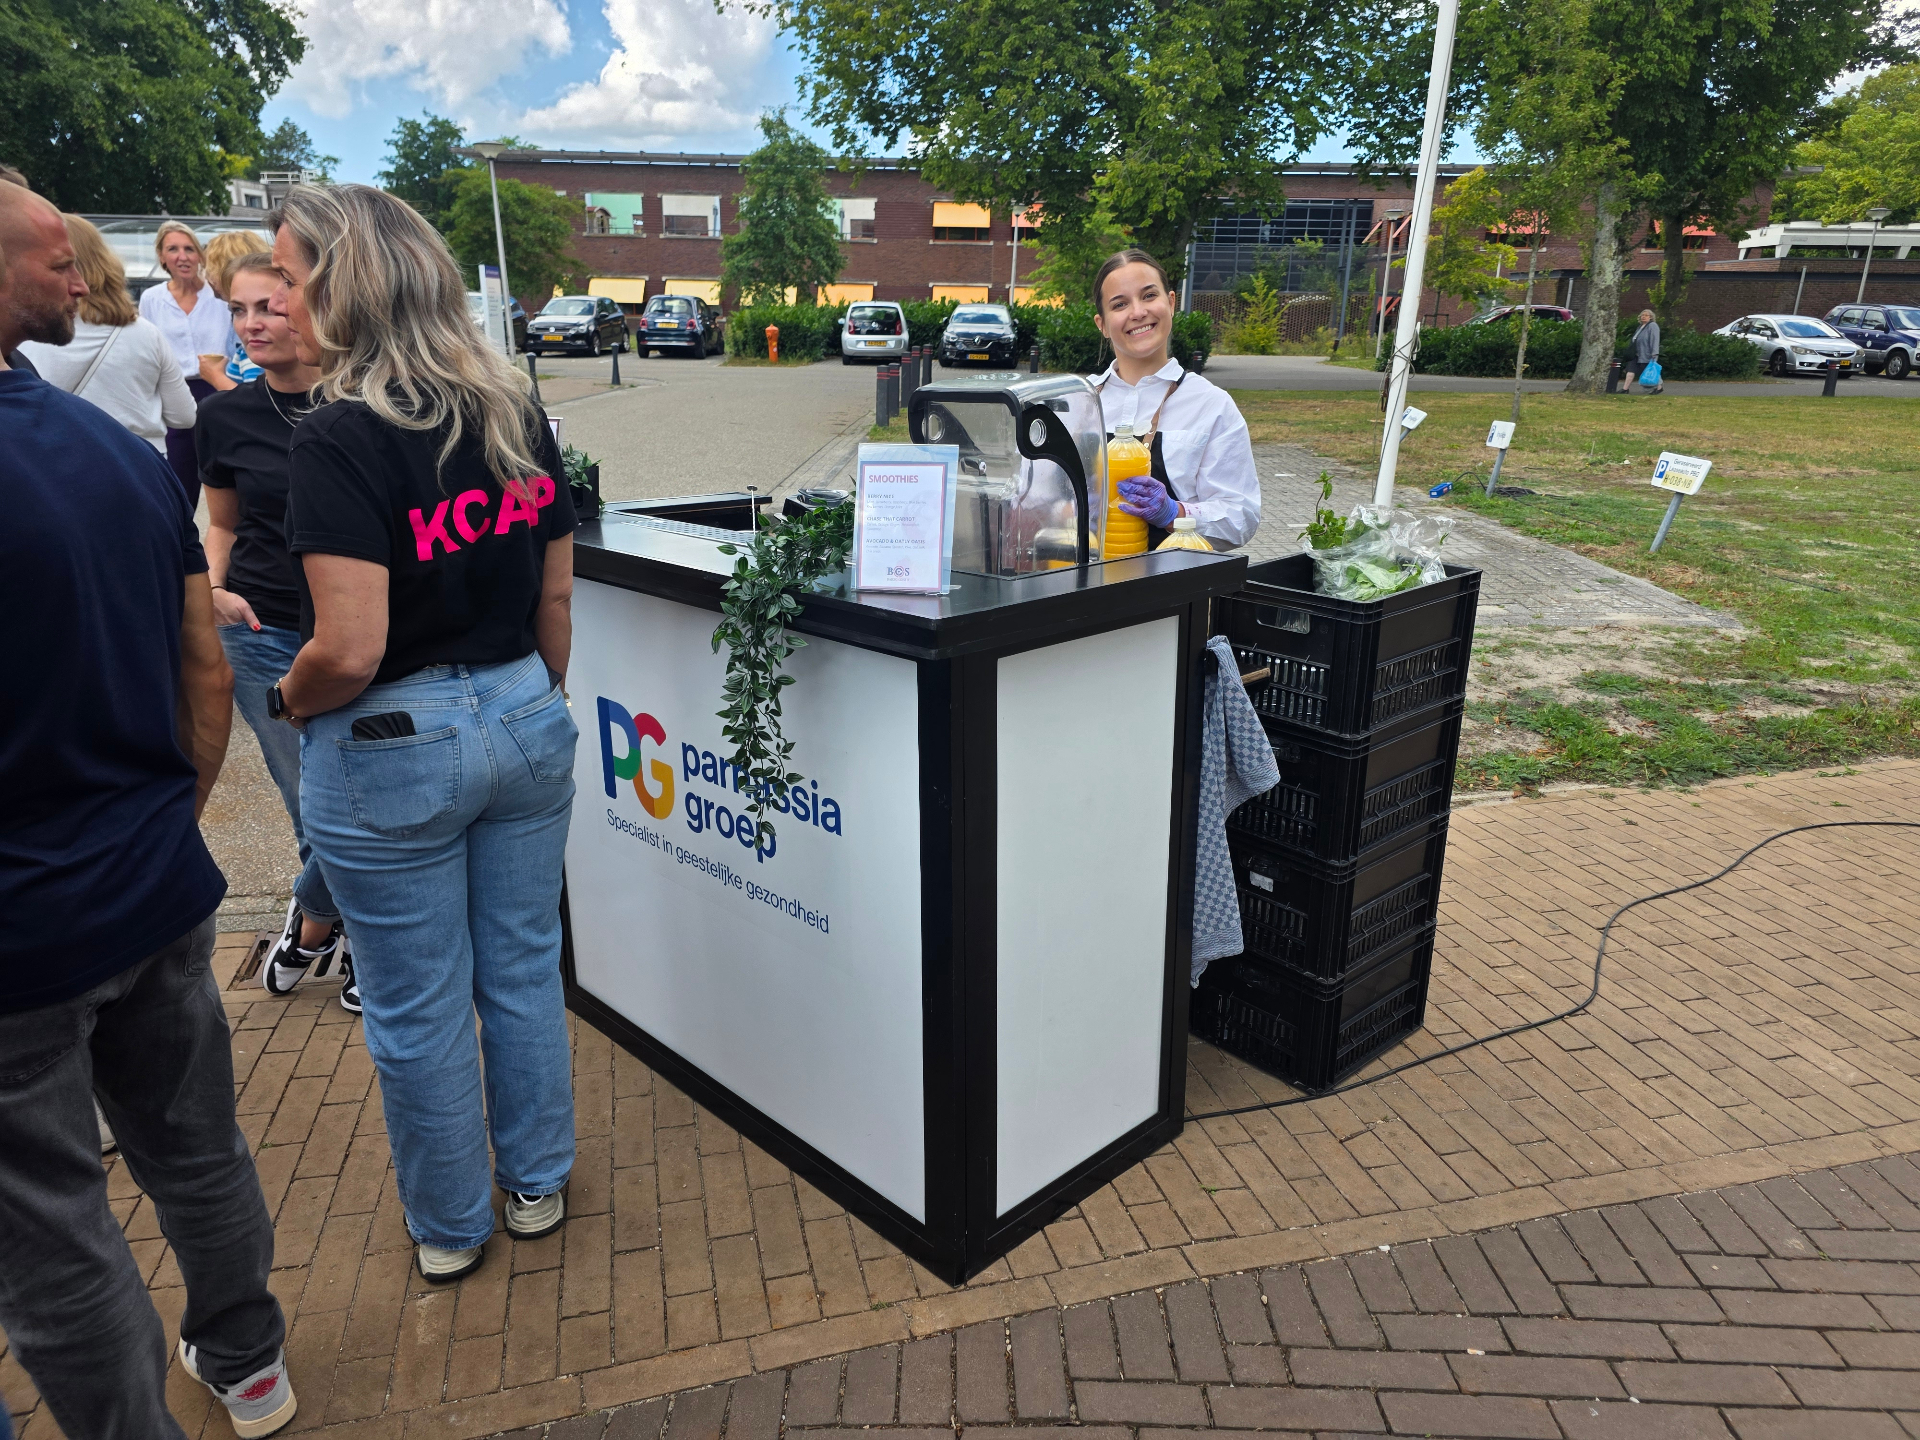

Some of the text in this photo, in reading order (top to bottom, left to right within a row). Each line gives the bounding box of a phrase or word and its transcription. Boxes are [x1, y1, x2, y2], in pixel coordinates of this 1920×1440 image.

[408, 476, 556, 561] KCAP
[868, 474, 919, 484] SMOOTHIES
[685, 791, 777, 864] groep
[606, 808, 830, 934] Specialist in geestelijke gezondheid
